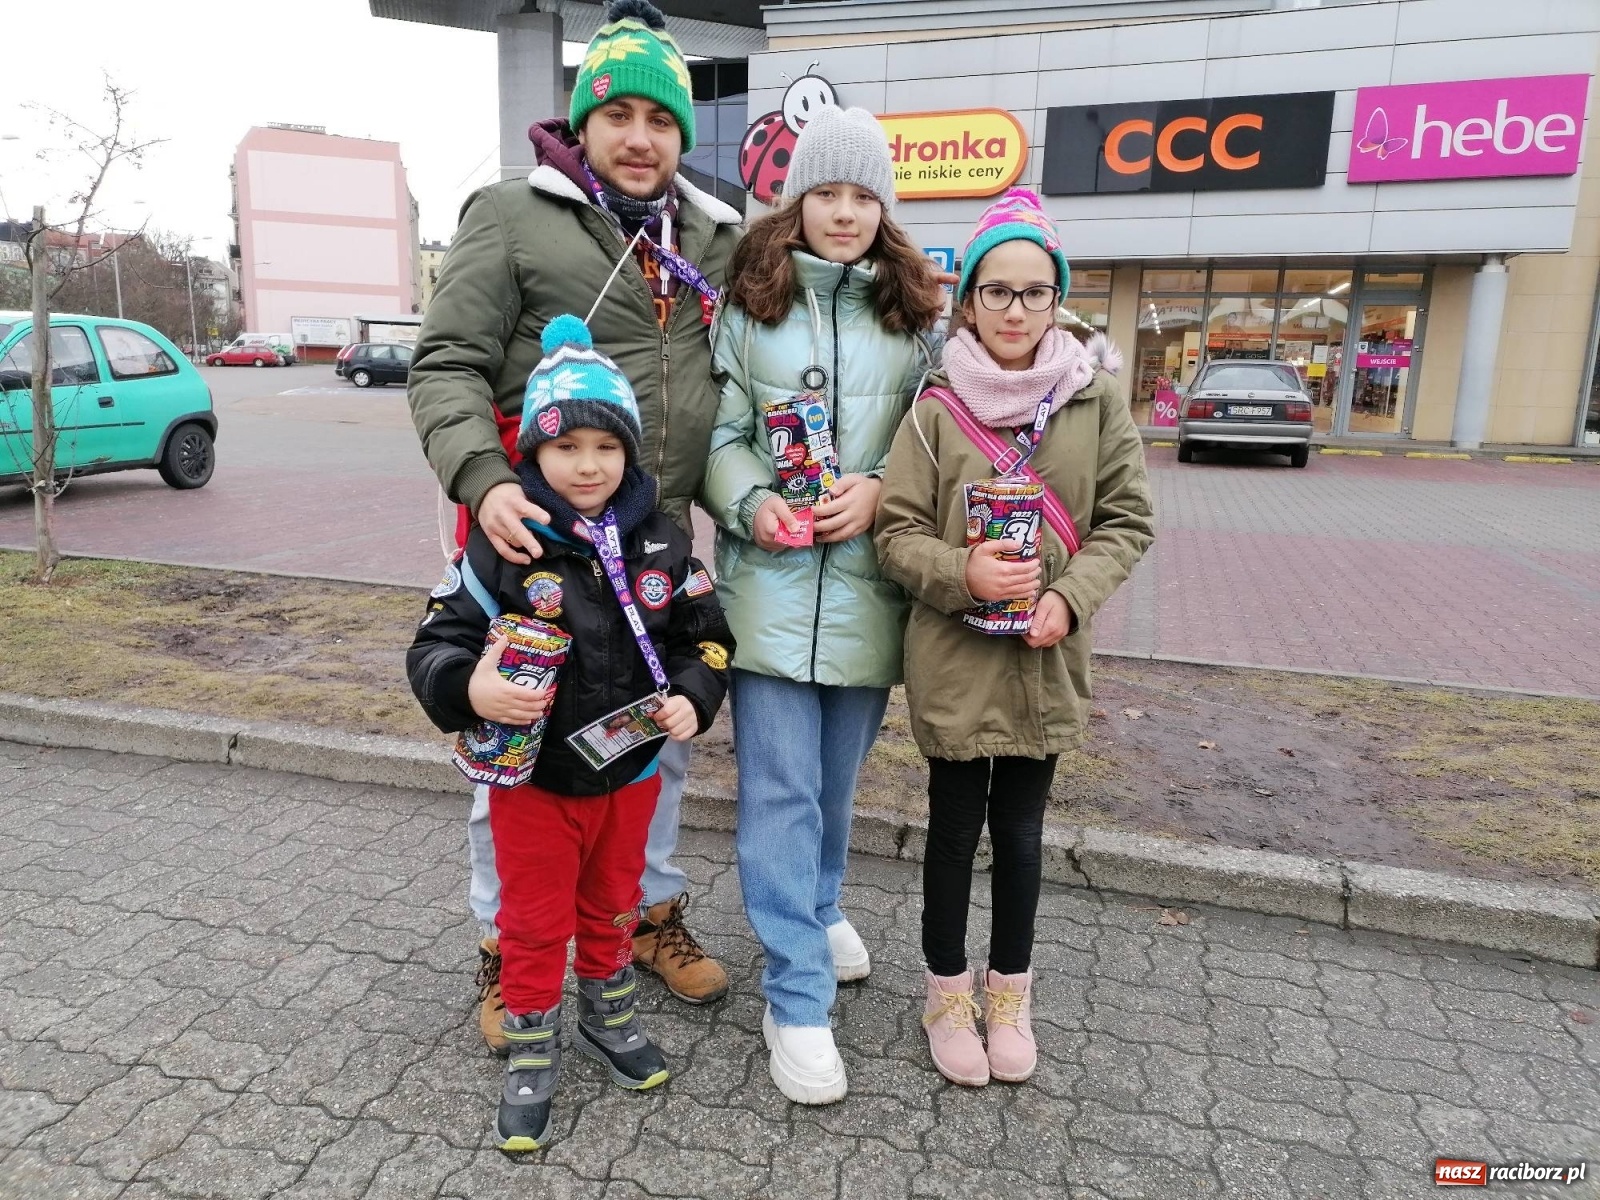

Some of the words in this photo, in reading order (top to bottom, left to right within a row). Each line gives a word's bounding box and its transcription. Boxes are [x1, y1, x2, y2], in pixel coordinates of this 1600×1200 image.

[1411, 98, 1576, 160] hebe
[1104, 112, 1263, 175] CCC
[918, 165, 962, 180] niskie
[968, 166, 1004, 180] ceny
[808, 413, 823, 424] tvn
[1036, 405, 1048, 429] PLAY
[607, 527, 620, 556] PLAY
[626, 606, 643, 633] PLAY
[963, 613, 1010, 630] PRZEJRZYJ
[519, 663, 545, 674] 2022
[498, 774, 516, 786] NA
